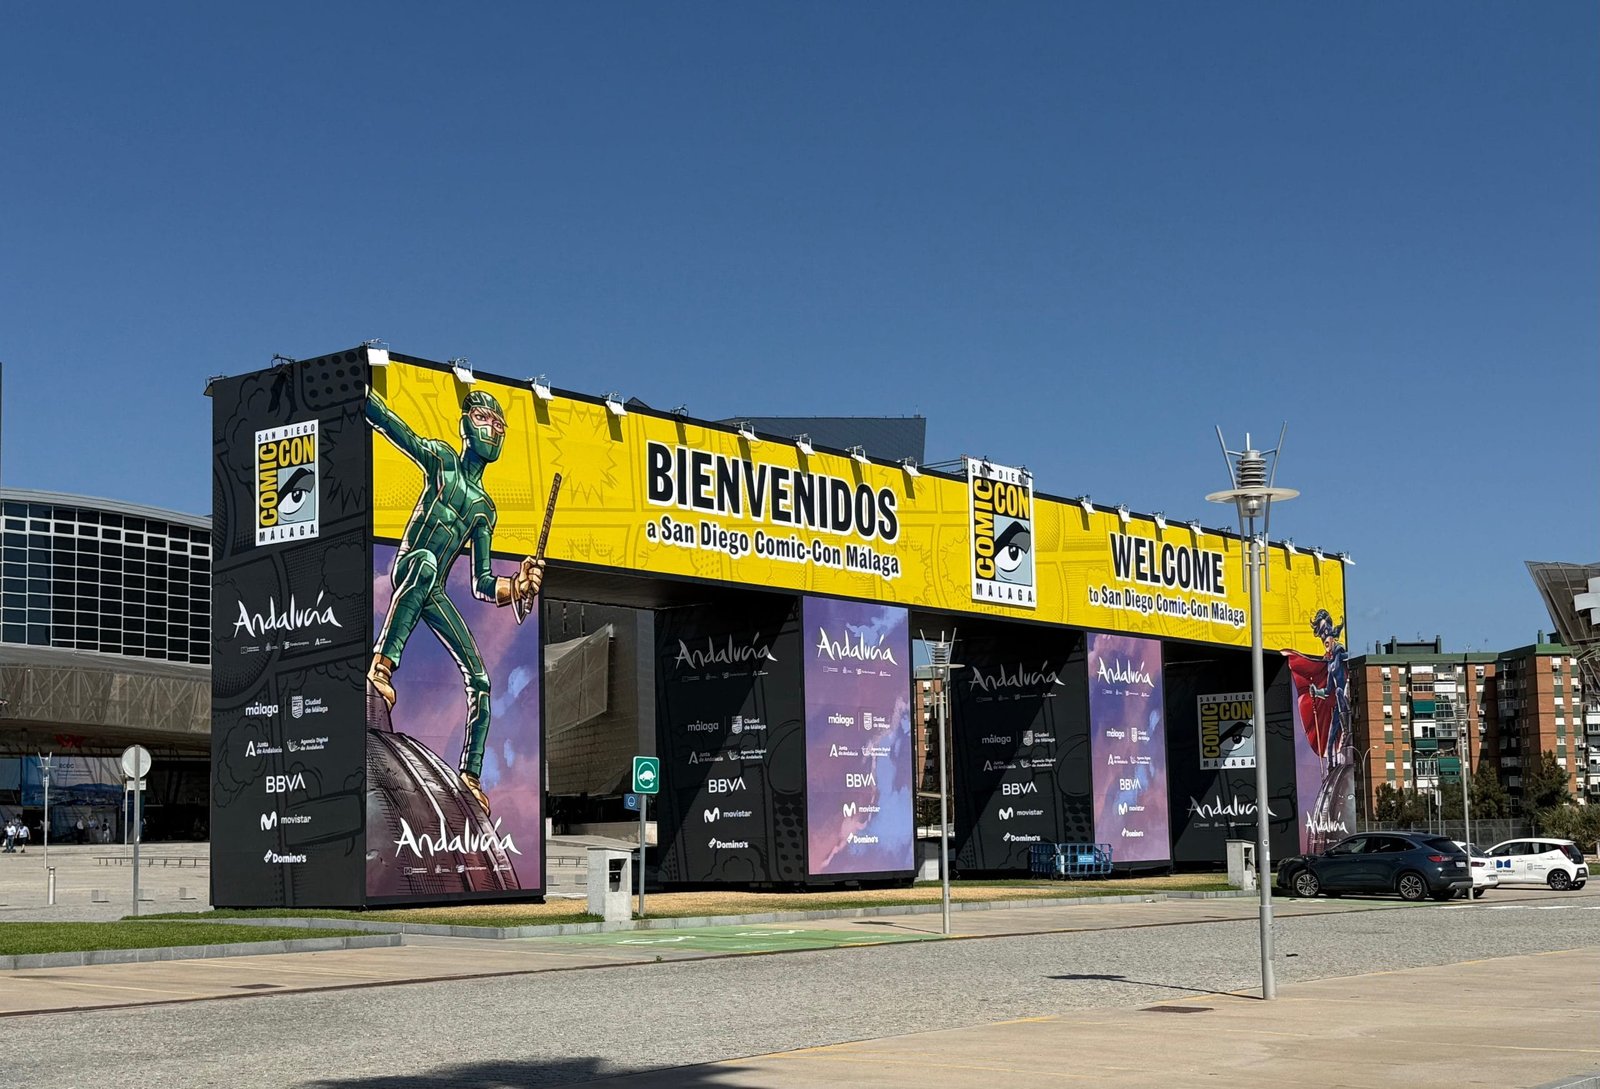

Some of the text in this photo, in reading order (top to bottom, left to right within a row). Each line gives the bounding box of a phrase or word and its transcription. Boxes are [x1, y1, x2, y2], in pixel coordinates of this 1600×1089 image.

[258, 423, 315, 442] SAN DIEGO
[278, 434, 314, 467] CON
[259, 442, 278, 526] COMIC
[647, 441, 898, 541] BIENVENIDOS
[994, 482, 1030, 519] CON
[259, 524, 315, 542] MÁLAGA
[974, 478, 995, 579] COMIC
[647, 516, 899, 576] a San Diego Comic-Con Málaga
[1110, 533, 1225, 594] WELCOME
[976, 582, 1032, 603] MÁLAGA
[233, 590, 343, 638] Andalucía
[1089, 585, 1245, 626] to San Diego Comic-Con Málaga
[674, 631, 778, 669] Andalucía
[816, 626, 898, 666] Andalucía
[968, 660, 1066, 692] Andalucía
[1097, 656, 1155, 688] Andalucía
[305, 698, 321, 706] Ciudad
[312, 705, 328, 714] Málaga
[1220, 701, 1253, 720] CON
[1202, 703, 1220, 758] COMIC
[266, 772, 306, 793] BBVA
[708, 777, 746, 793] BBVA
[846, 772, 876, 788] BBVA
[1002, 781, 1038, 795] BBVA
[1119, 778, 1142, 790] BBVA
[280, 814, 311, 824] movistar
[723, 810, 752, 818] movistar
[858, 805, 880, 813] movistar
[1016, 808, 1044, 816] movistar
[1305, 811, 1349, 835] Andalucía
[394, 817, 523, 858] Andalucía
[716, 840, 749, 849] Domino's
[272, 852, 307, 863] Domino's
